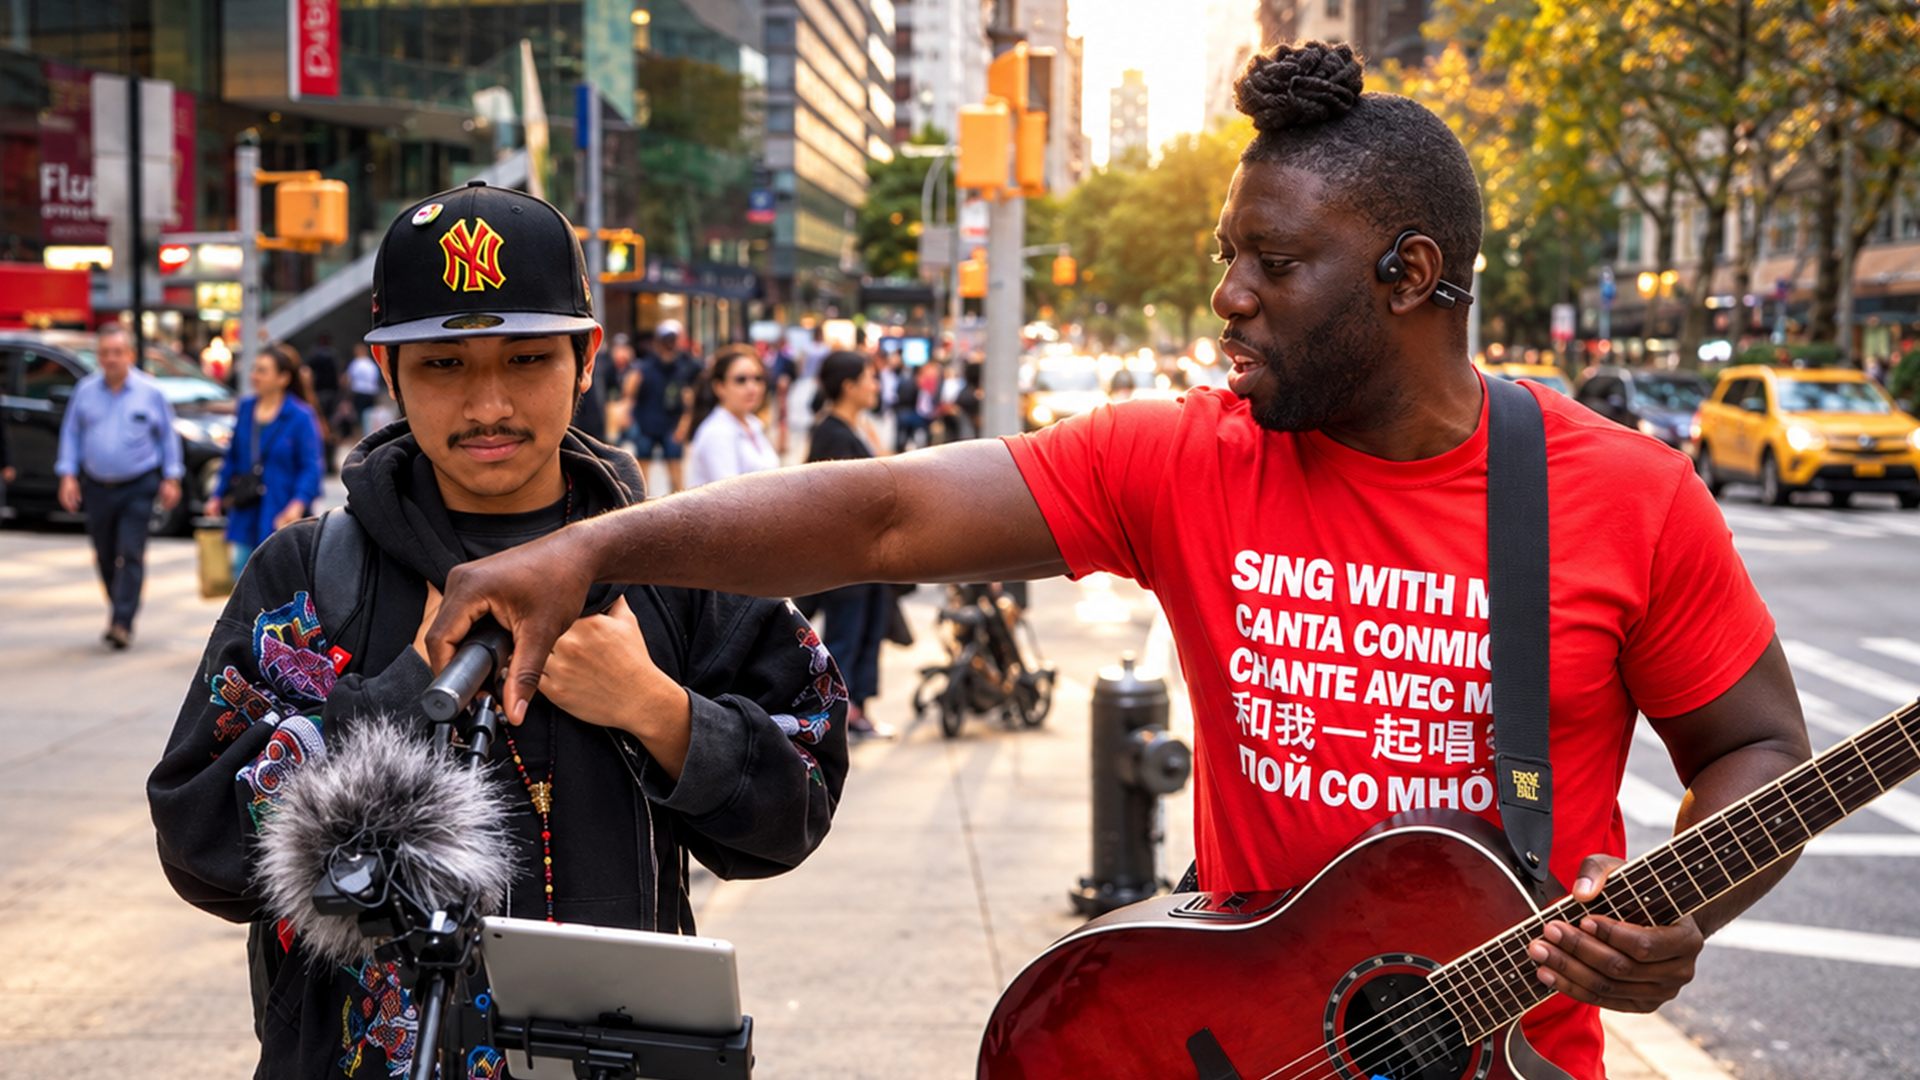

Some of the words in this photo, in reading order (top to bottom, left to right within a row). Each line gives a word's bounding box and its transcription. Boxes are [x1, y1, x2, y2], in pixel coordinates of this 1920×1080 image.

[439, 217, 506, 292] NY
[1231, 549, 1334, 601] SING
[1346, 562, 1455, 615] WITH
[1466, 577, 1489, 619] M
[1236, 603, 1345, 653] CANTA
[1229, 647, 1358, 702] CHANTE
[1363, 669, 1455, 712] AVEC
[1463, 681, 1493, 714] M
[1232, 691, 1495, 764] 和我一起唱
[1239, 744, 1312, 801] ПОЙ
[1319, 770, 1379, 810] СО
[1388, 767, 1499, 812] МНО
